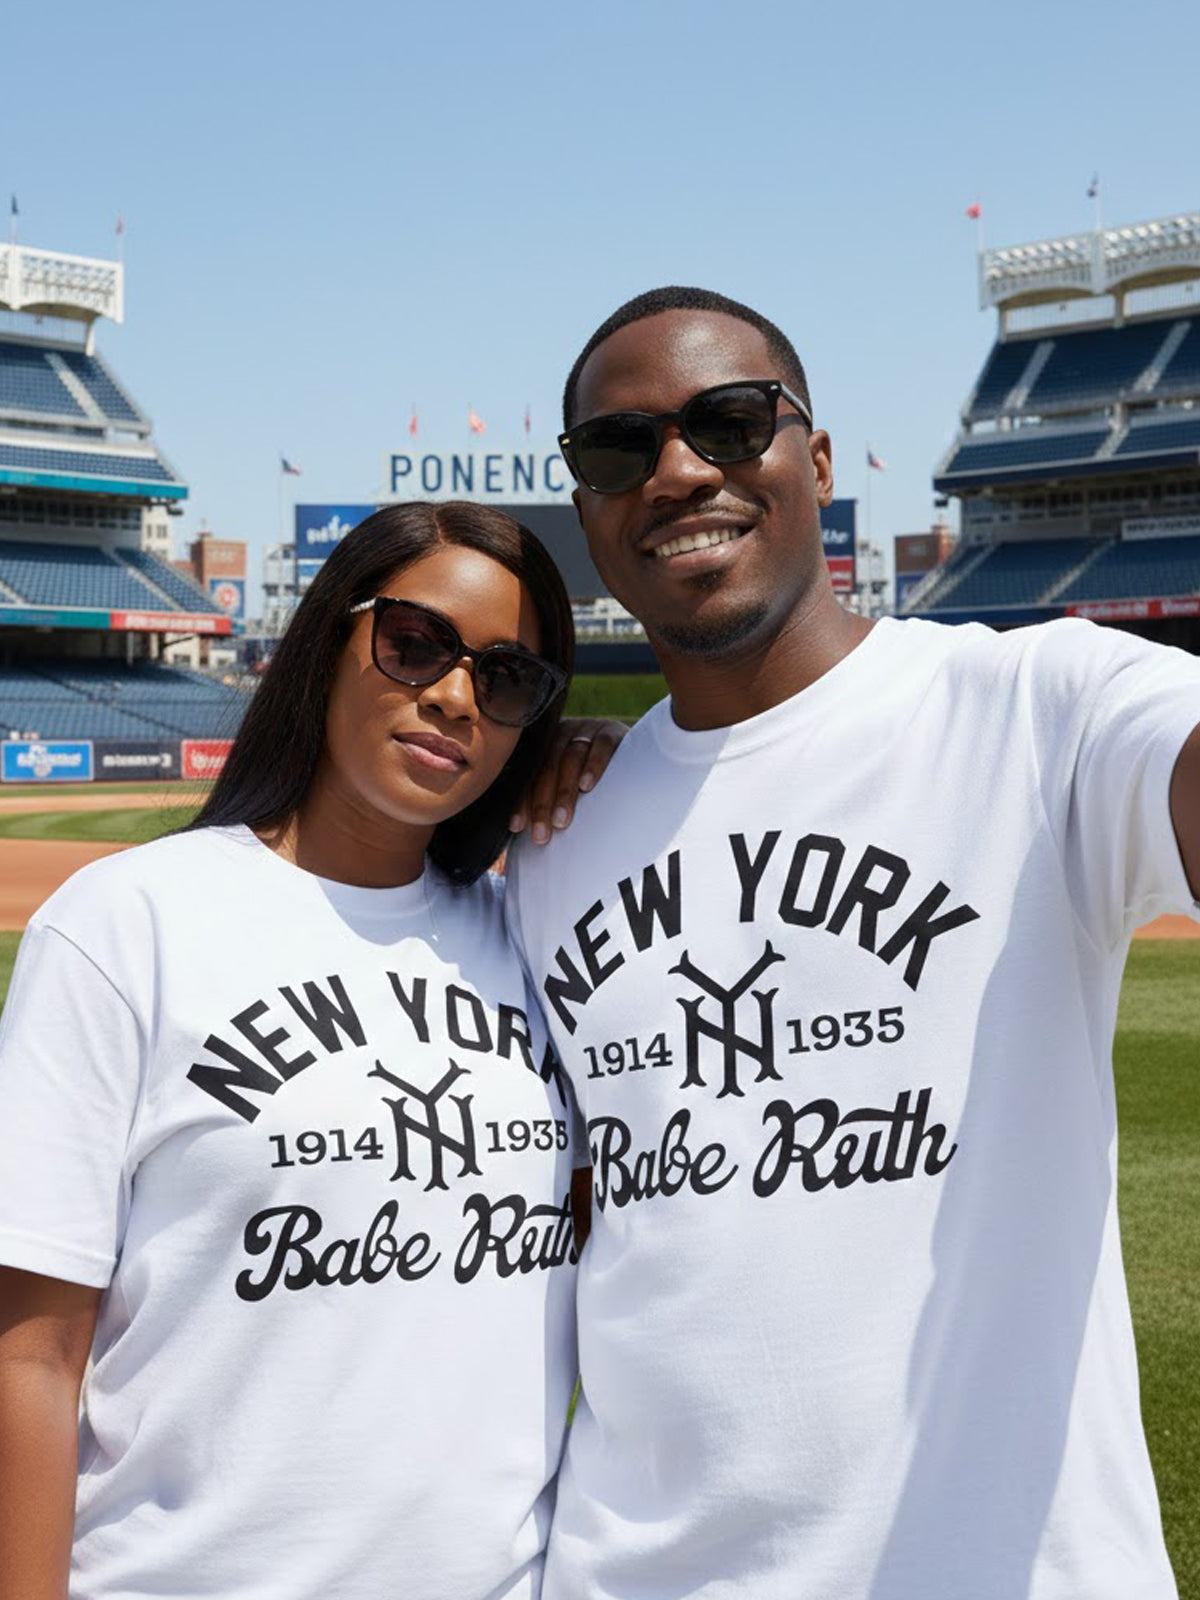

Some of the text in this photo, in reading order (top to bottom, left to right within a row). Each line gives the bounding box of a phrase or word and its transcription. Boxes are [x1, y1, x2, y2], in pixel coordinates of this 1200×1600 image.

[543, 830, 981, 1036] NEW YORK
[186, 974, 368, 1124] NEW
[583, 1032, 673, 1080] 1914
[786, 1006, 905, 1054] 1935
[269, 1127, 384, 1168] 1914
[587, 1087, 958, 1213] Babe Ruth
[235, 1199, 442, 1302] Babe
